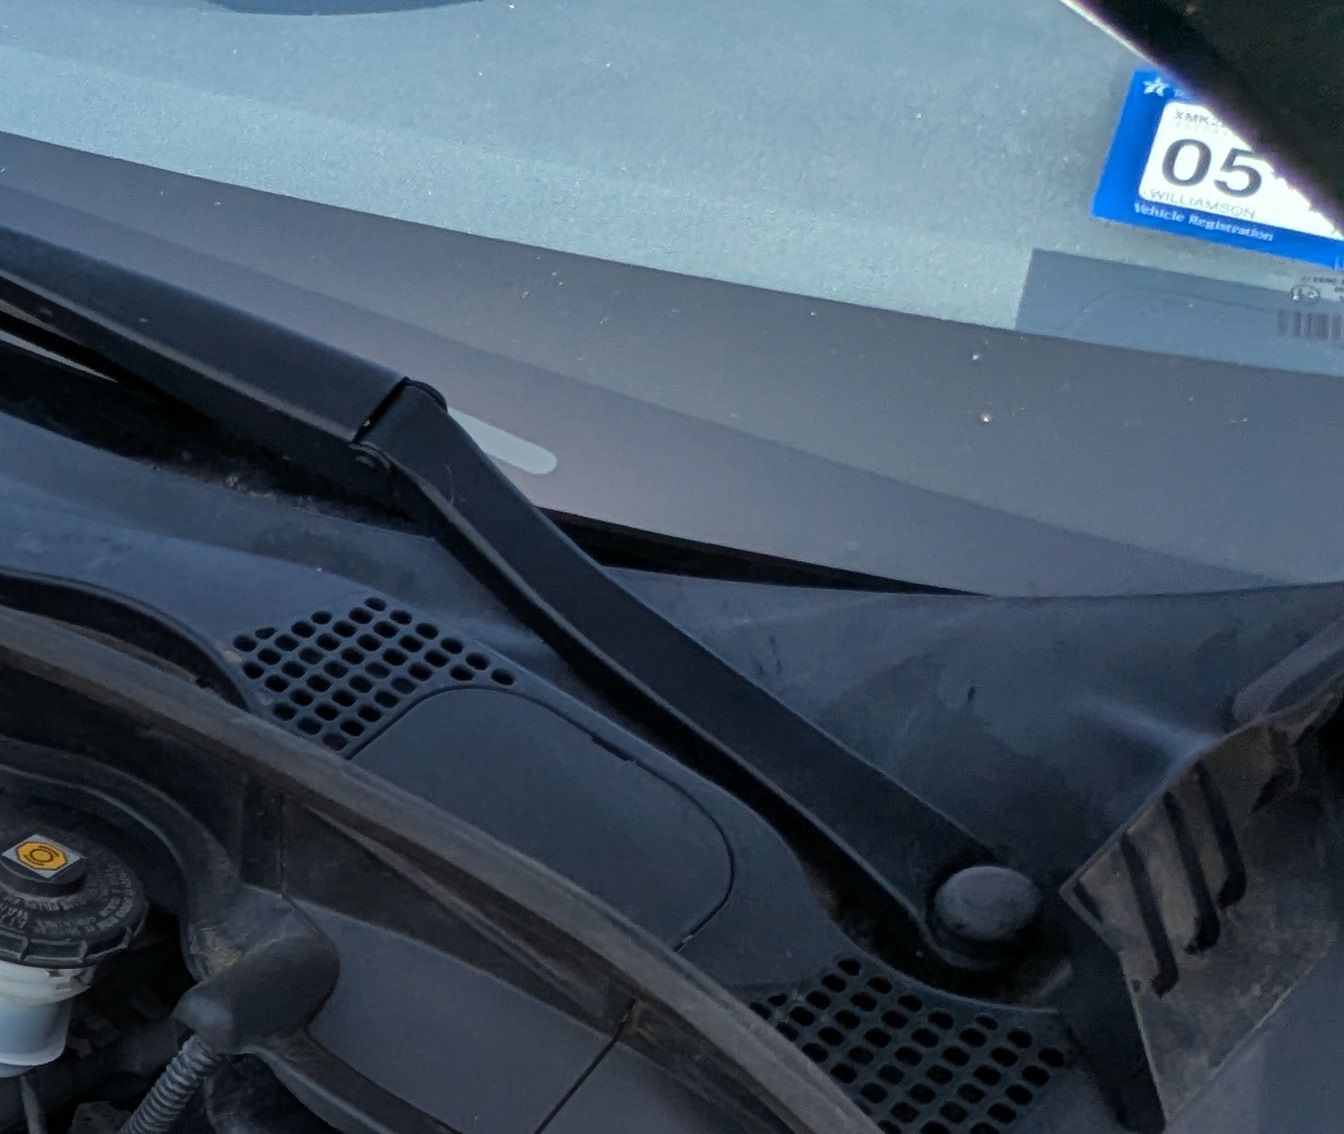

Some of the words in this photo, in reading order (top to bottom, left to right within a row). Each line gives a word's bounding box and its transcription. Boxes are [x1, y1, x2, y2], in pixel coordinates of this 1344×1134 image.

[1133, 201, 1185, 223] Vehicle
[1188, 215, 1274, 242] Registration
[1149, 188, 1257, 219] WILLIAMSON
